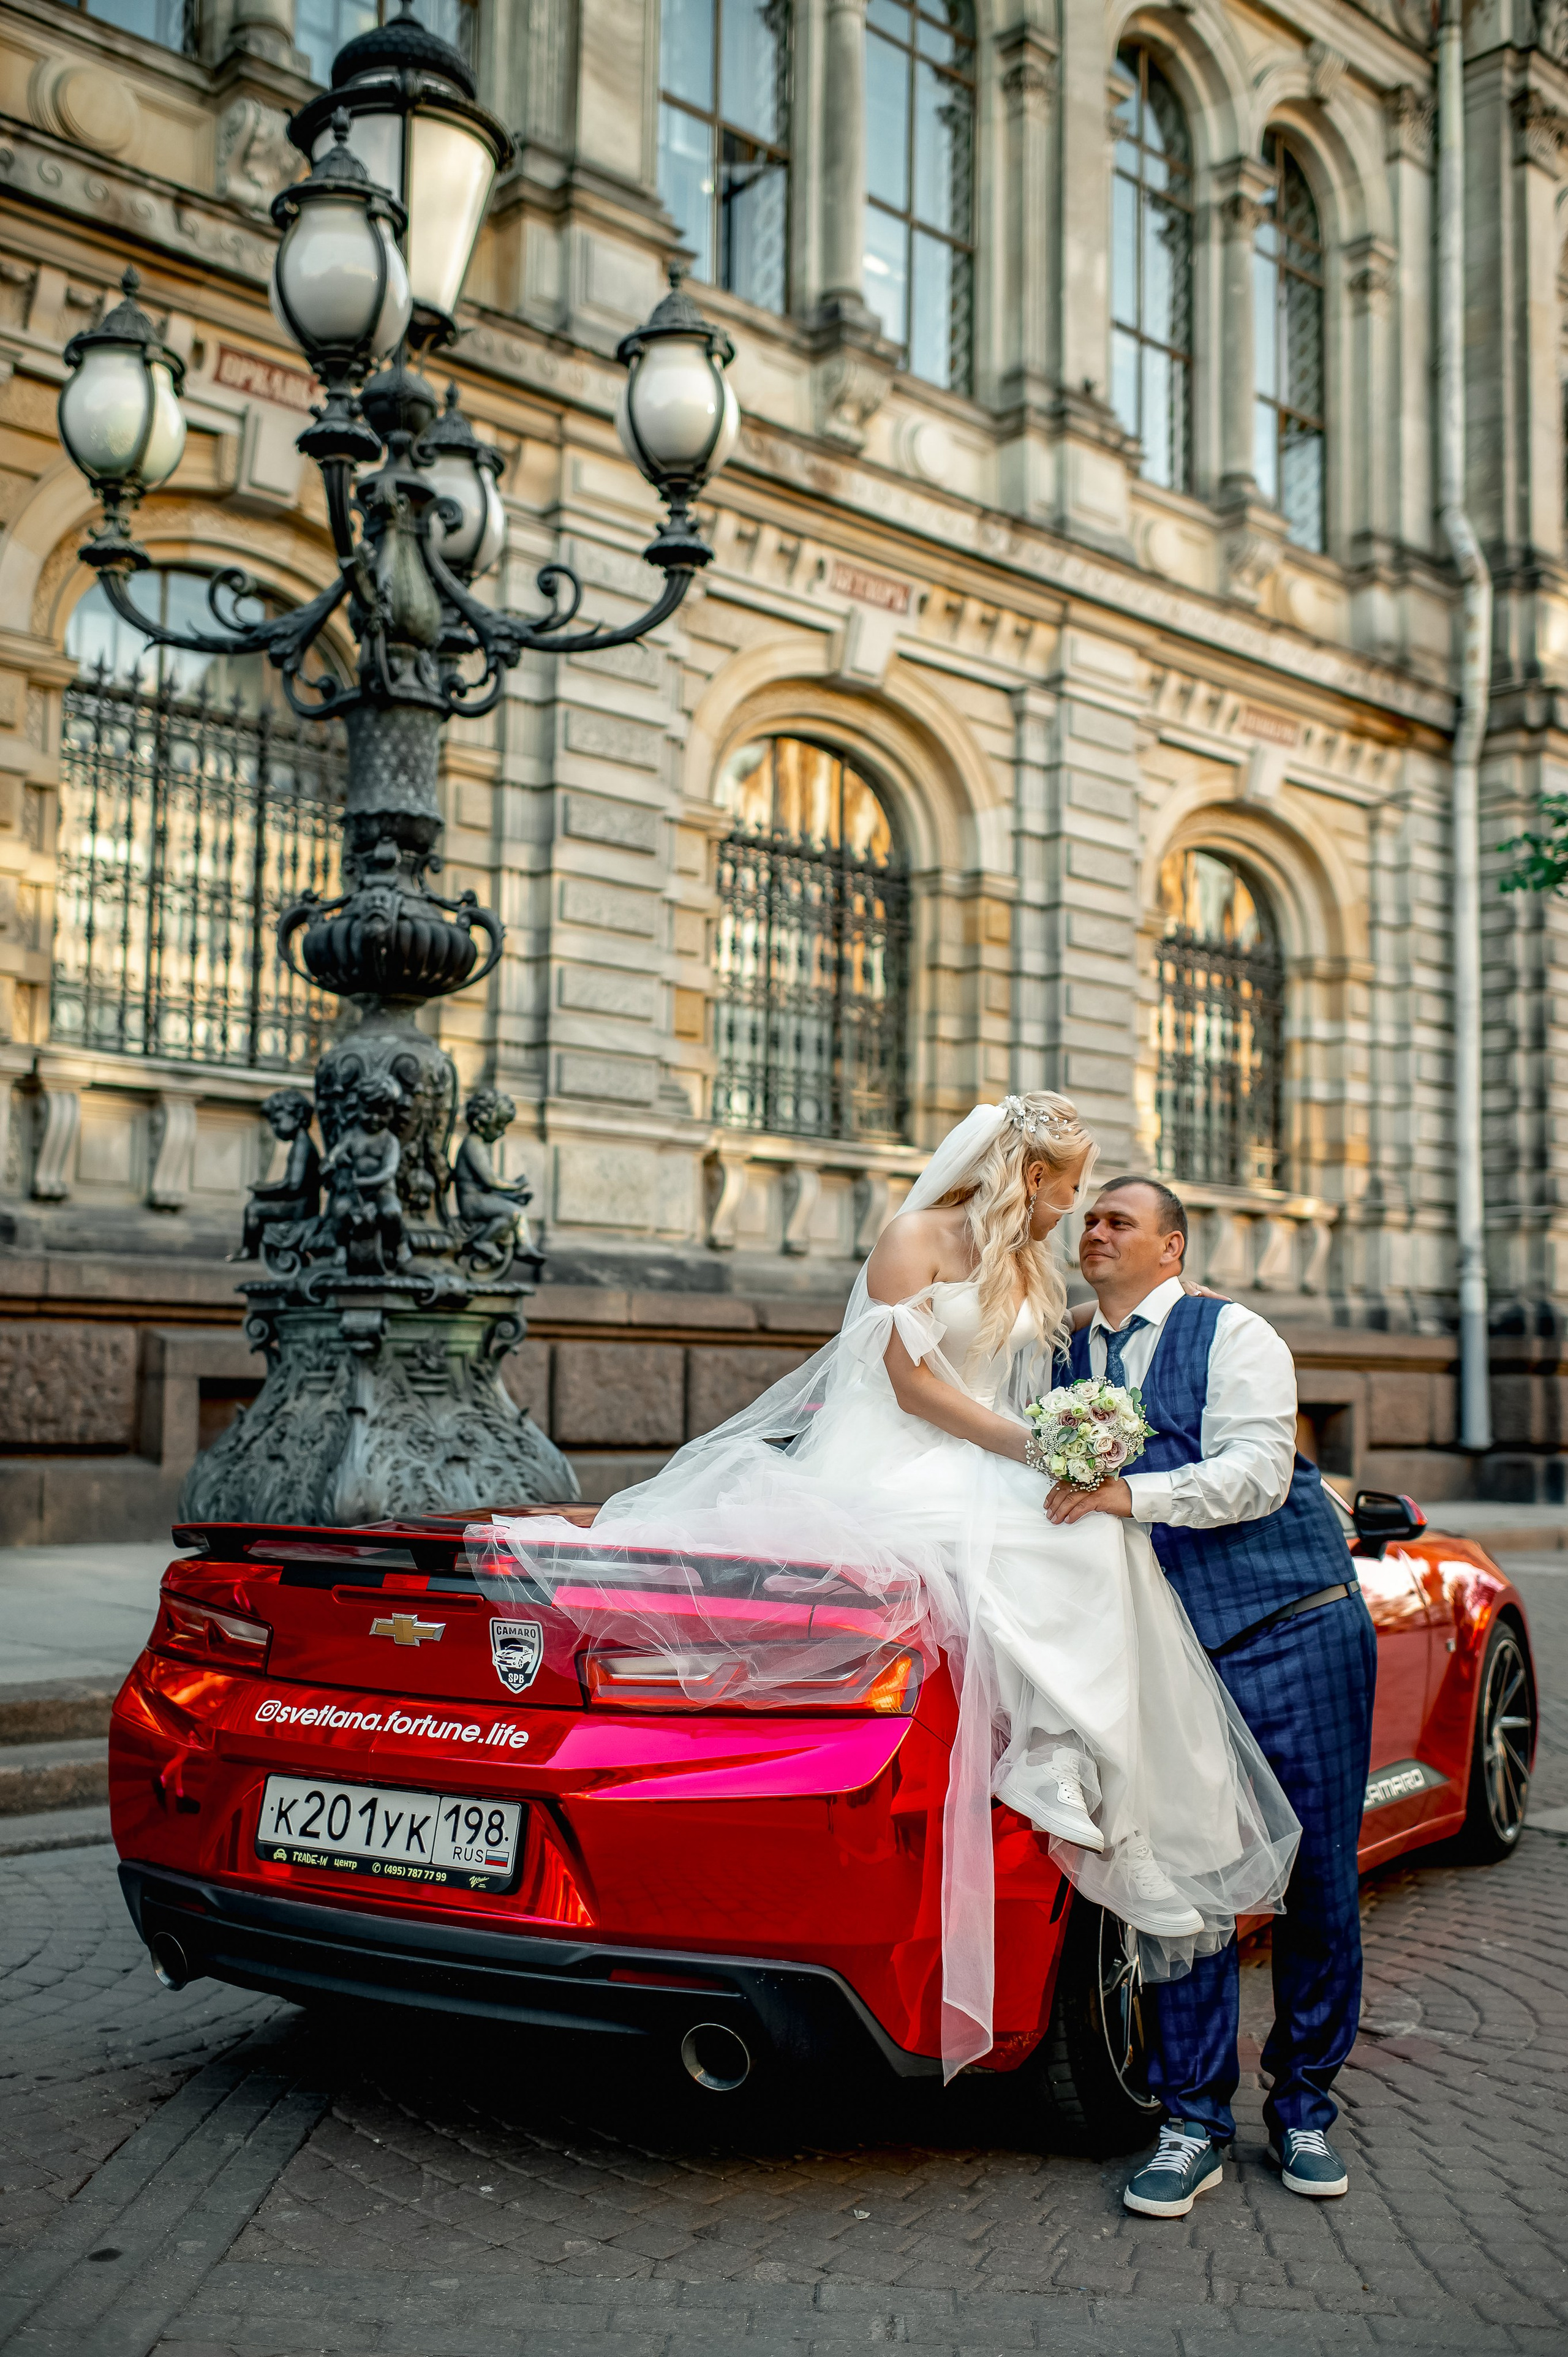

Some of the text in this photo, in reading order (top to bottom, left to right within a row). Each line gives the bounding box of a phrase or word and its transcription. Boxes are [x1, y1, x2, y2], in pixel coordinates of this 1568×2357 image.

[496, 1625, 537, 1639] CAMARO
[508, 1673, 525, 1684] SPB
[443, 1803, 505, 1847] 198
[453, 1846, 484, 1863] RUS
[293, 1851, 447, 1882] TRADE-IN центр (495) 787 77 99
